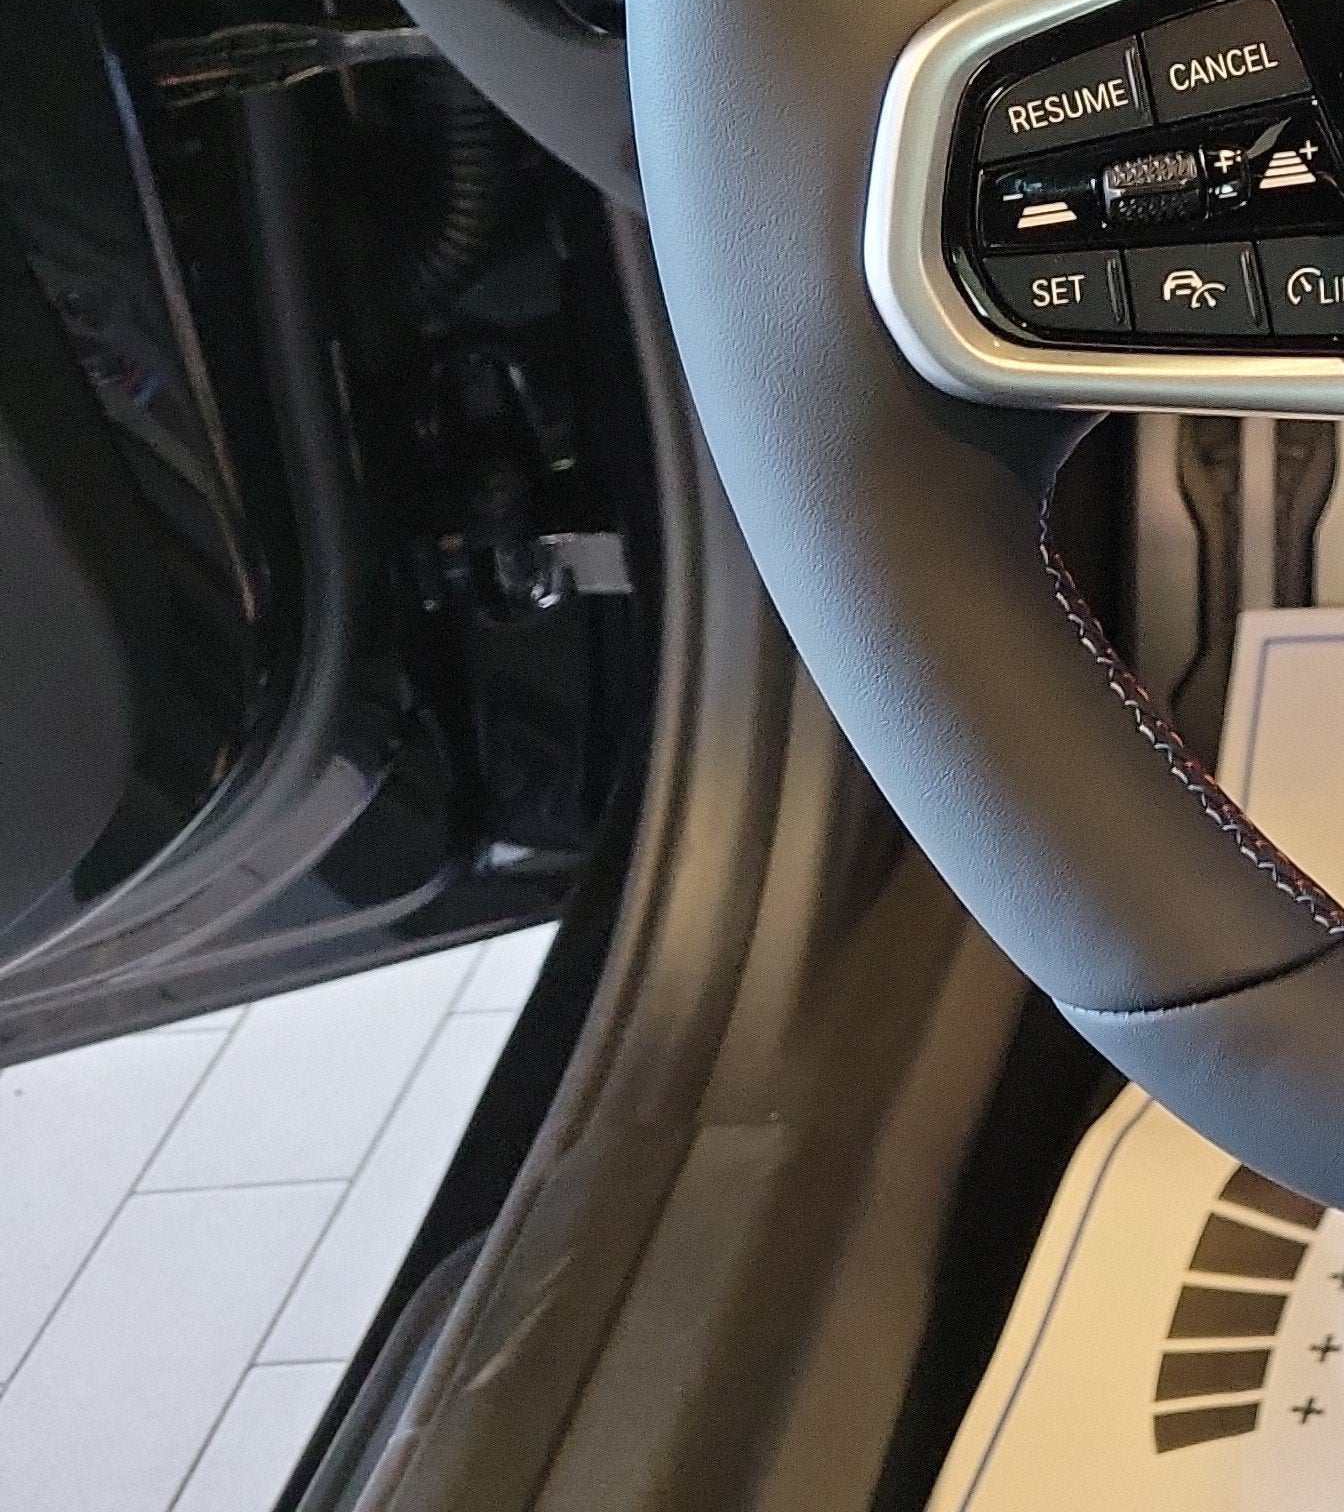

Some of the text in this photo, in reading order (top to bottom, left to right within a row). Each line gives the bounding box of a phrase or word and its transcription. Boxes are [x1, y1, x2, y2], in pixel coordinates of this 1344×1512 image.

[1169, 41, 1279, 92] CANCEL
[1007, 78, 1130, 134] RESUME
[1032, 274, 1086, 307] SET
